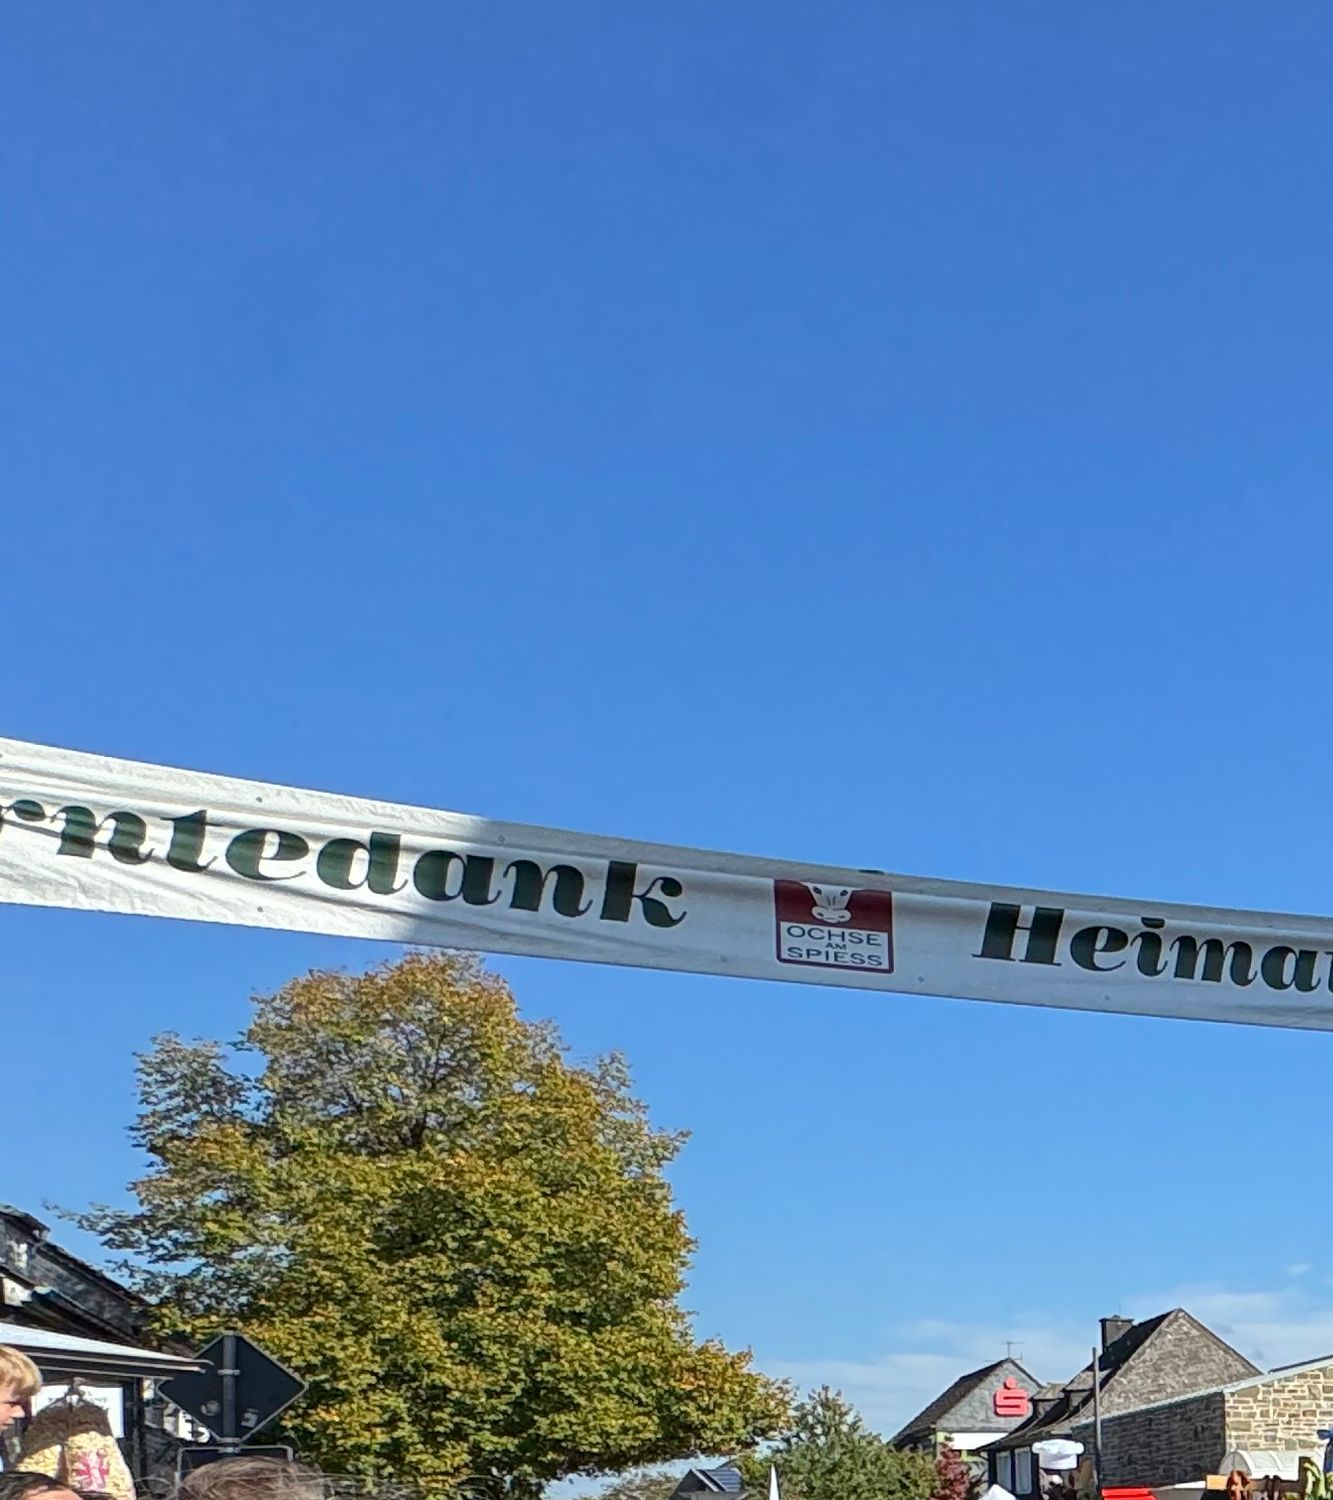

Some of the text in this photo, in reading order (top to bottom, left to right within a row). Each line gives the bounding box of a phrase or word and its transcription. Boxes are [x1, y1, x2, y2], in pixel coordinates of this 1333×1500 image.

[786, 925, 882, 947] OCHSE
[825, 941, 847, 951] AM
[787, 946, 883, 967] SPIESS
